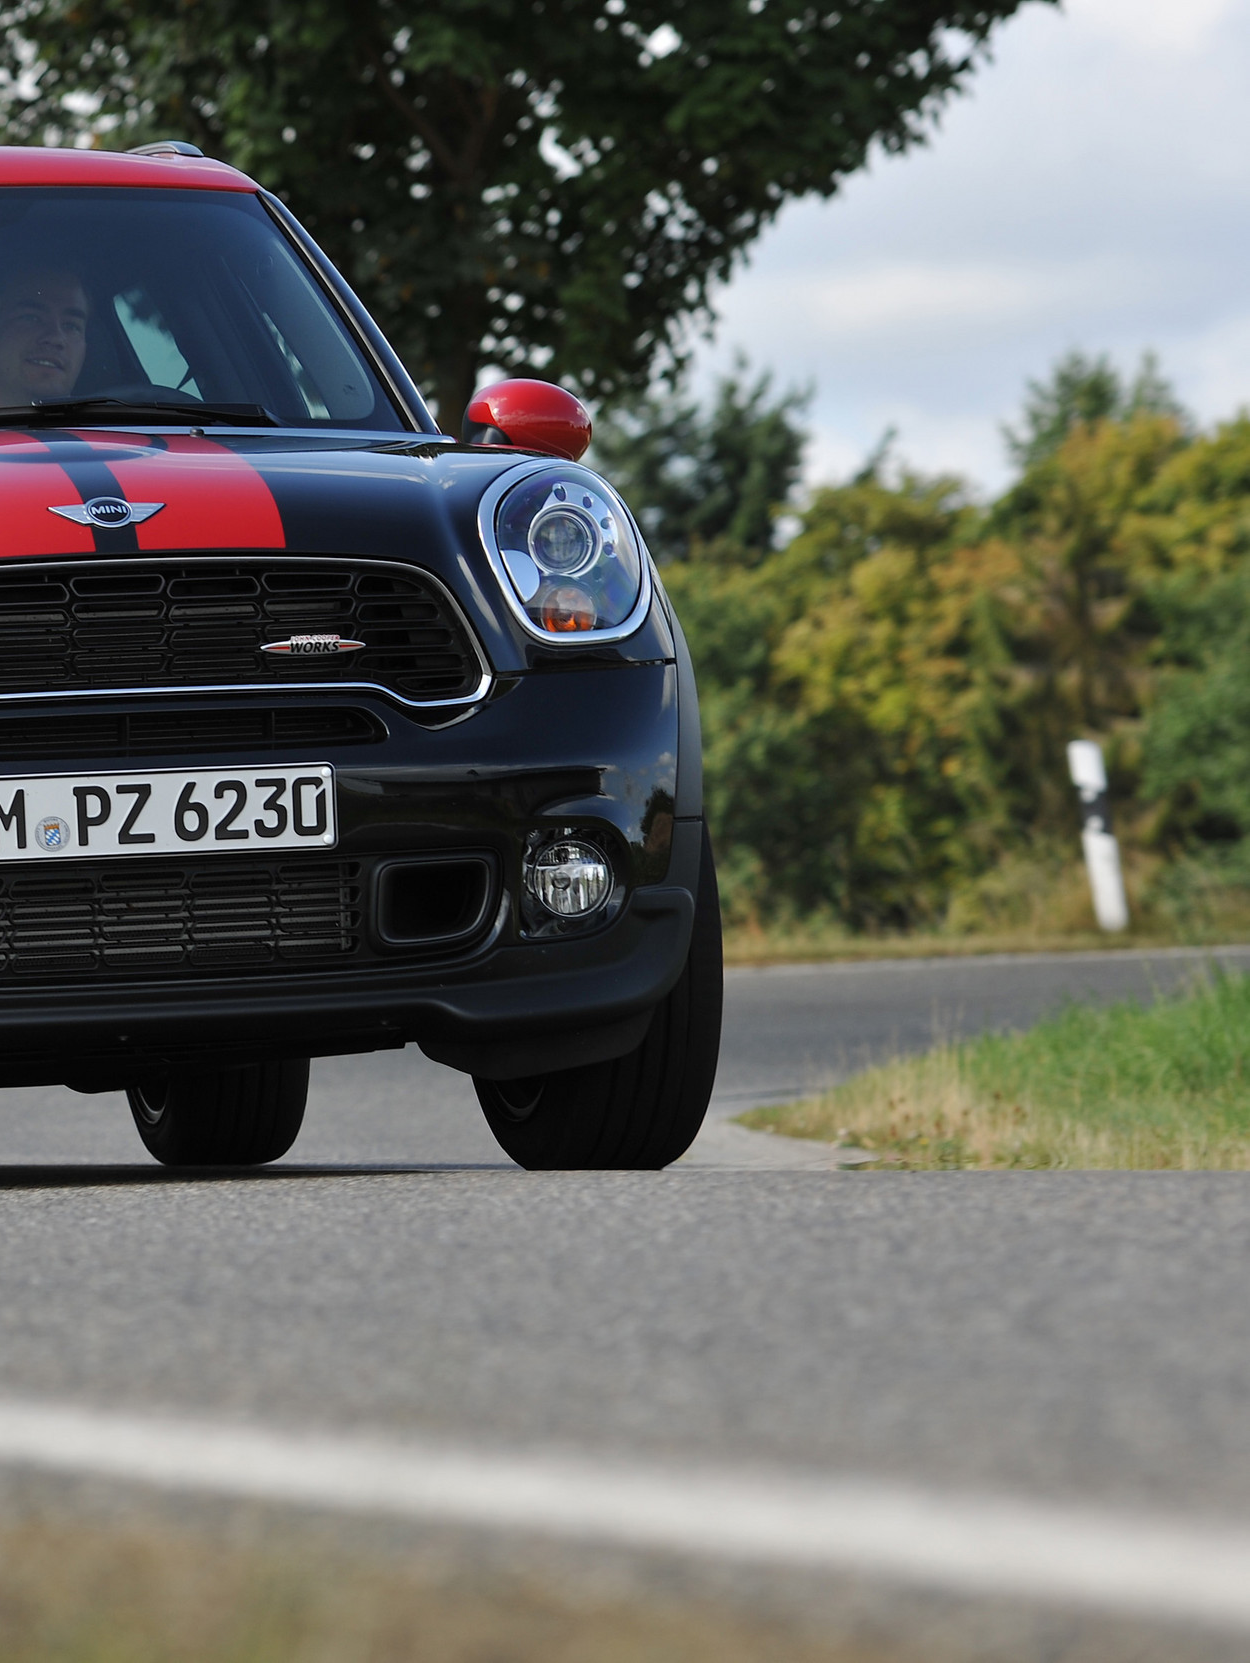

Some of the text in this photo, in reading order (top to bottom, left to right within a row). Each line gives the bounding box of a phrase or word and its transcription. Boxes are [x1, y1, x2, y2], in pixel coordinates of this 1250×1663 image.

[91, 505, 127, 515] MINI
[290, 641, 340, 653] WORKS
[73, 783, 156, 846] PZ
[174, 777, 327, 842] 6230
